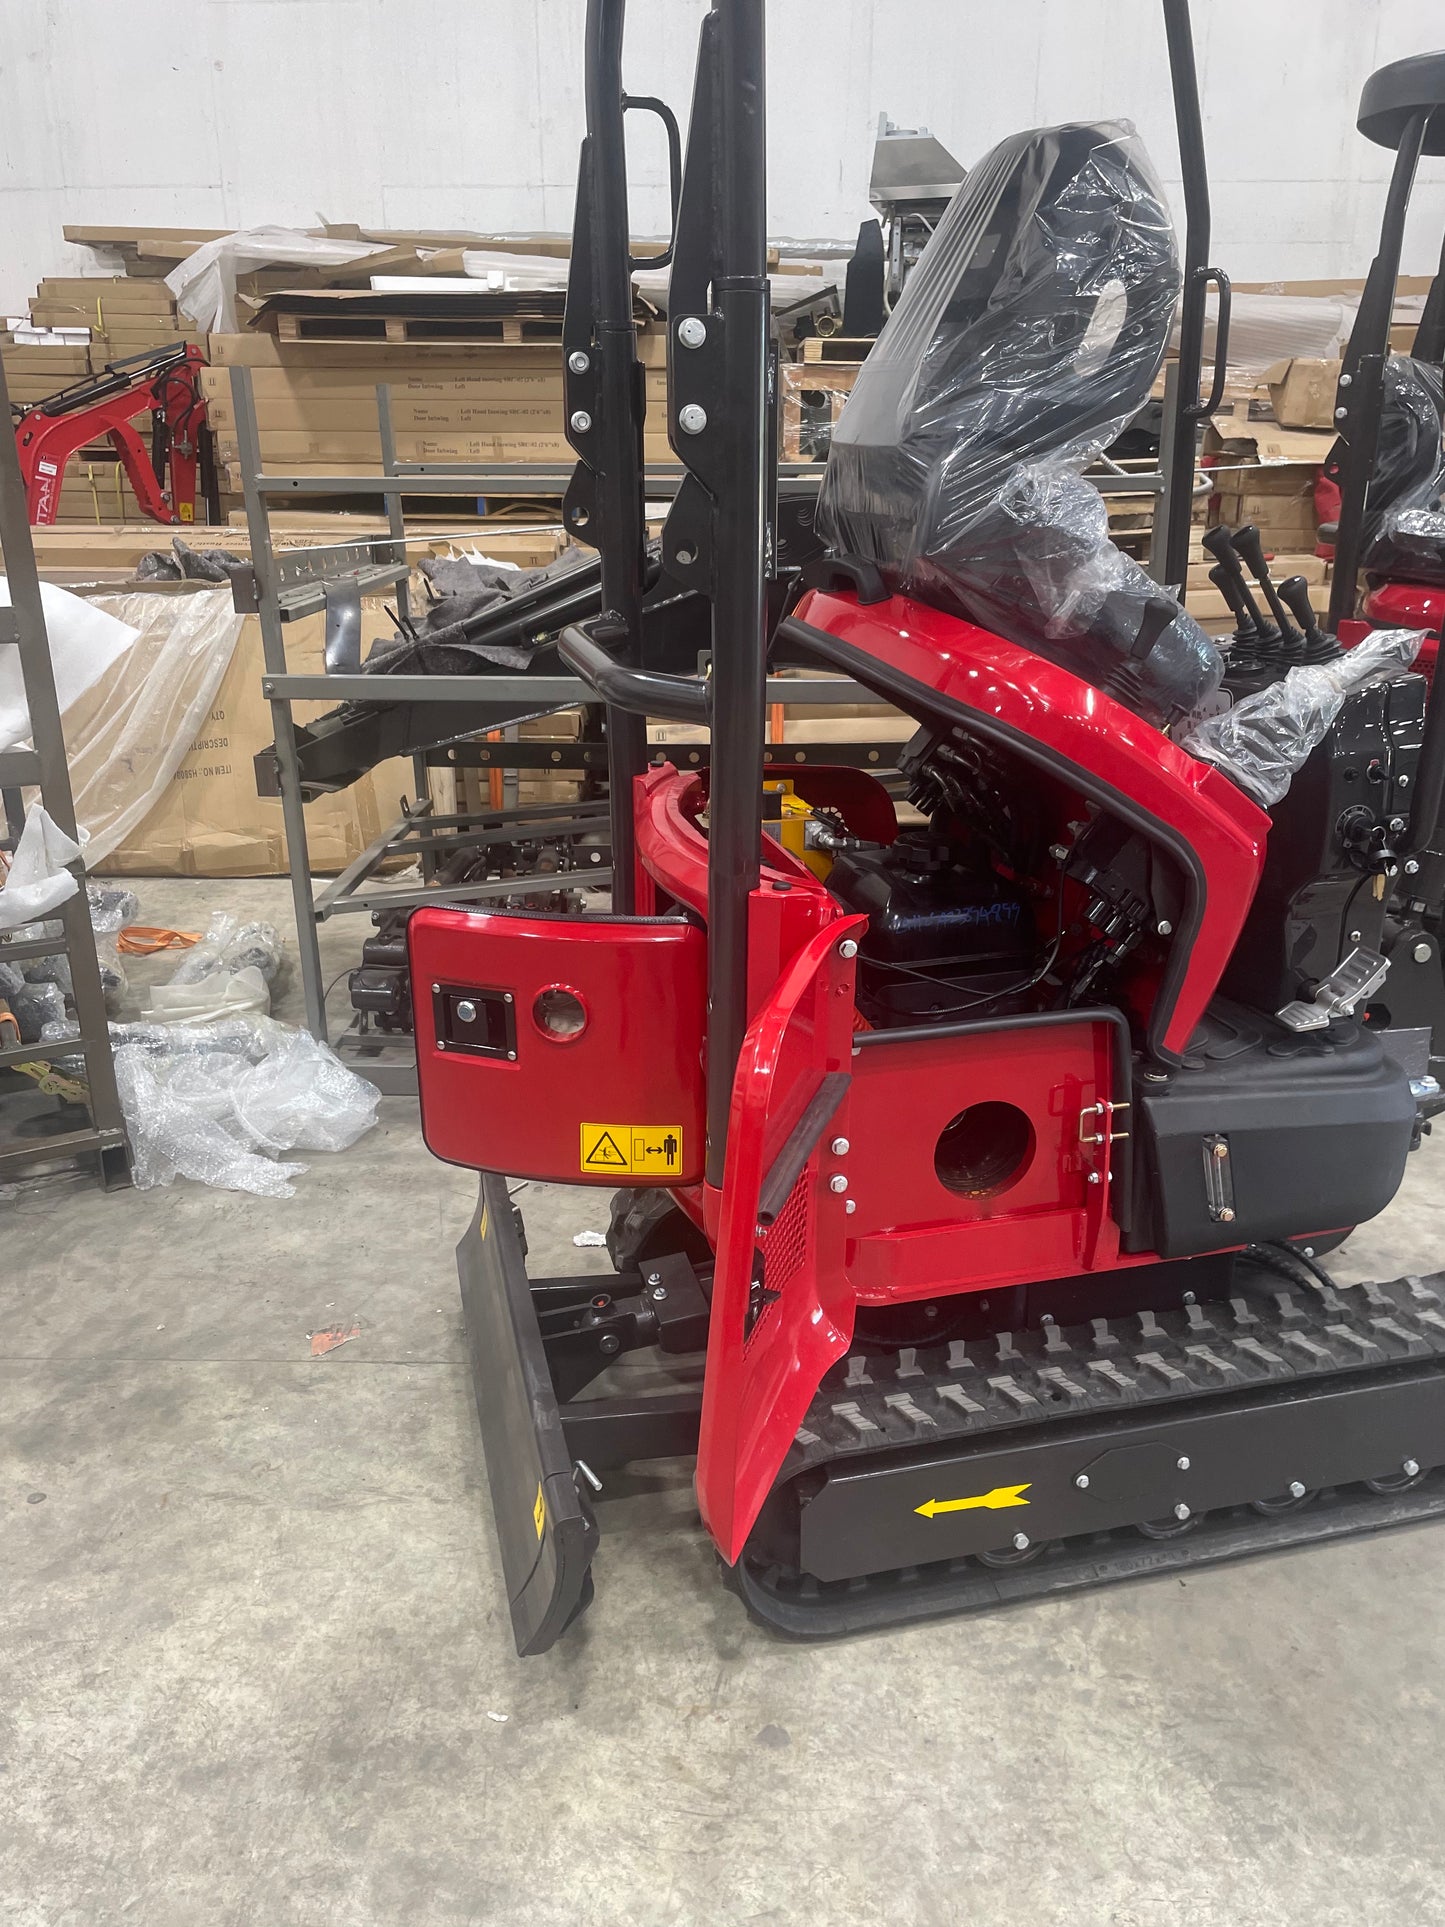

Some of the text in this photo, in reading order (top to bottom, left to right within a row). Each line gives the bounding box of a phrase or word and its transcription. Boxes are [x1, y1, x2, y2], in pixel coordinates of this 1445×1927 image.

[35, 475, 52, 525] ITAN
[211, 710, 225, 721] QTY
[188, 737, 229, 752] DESCRIPTI
[215, 764, 232, 776] ITEM
